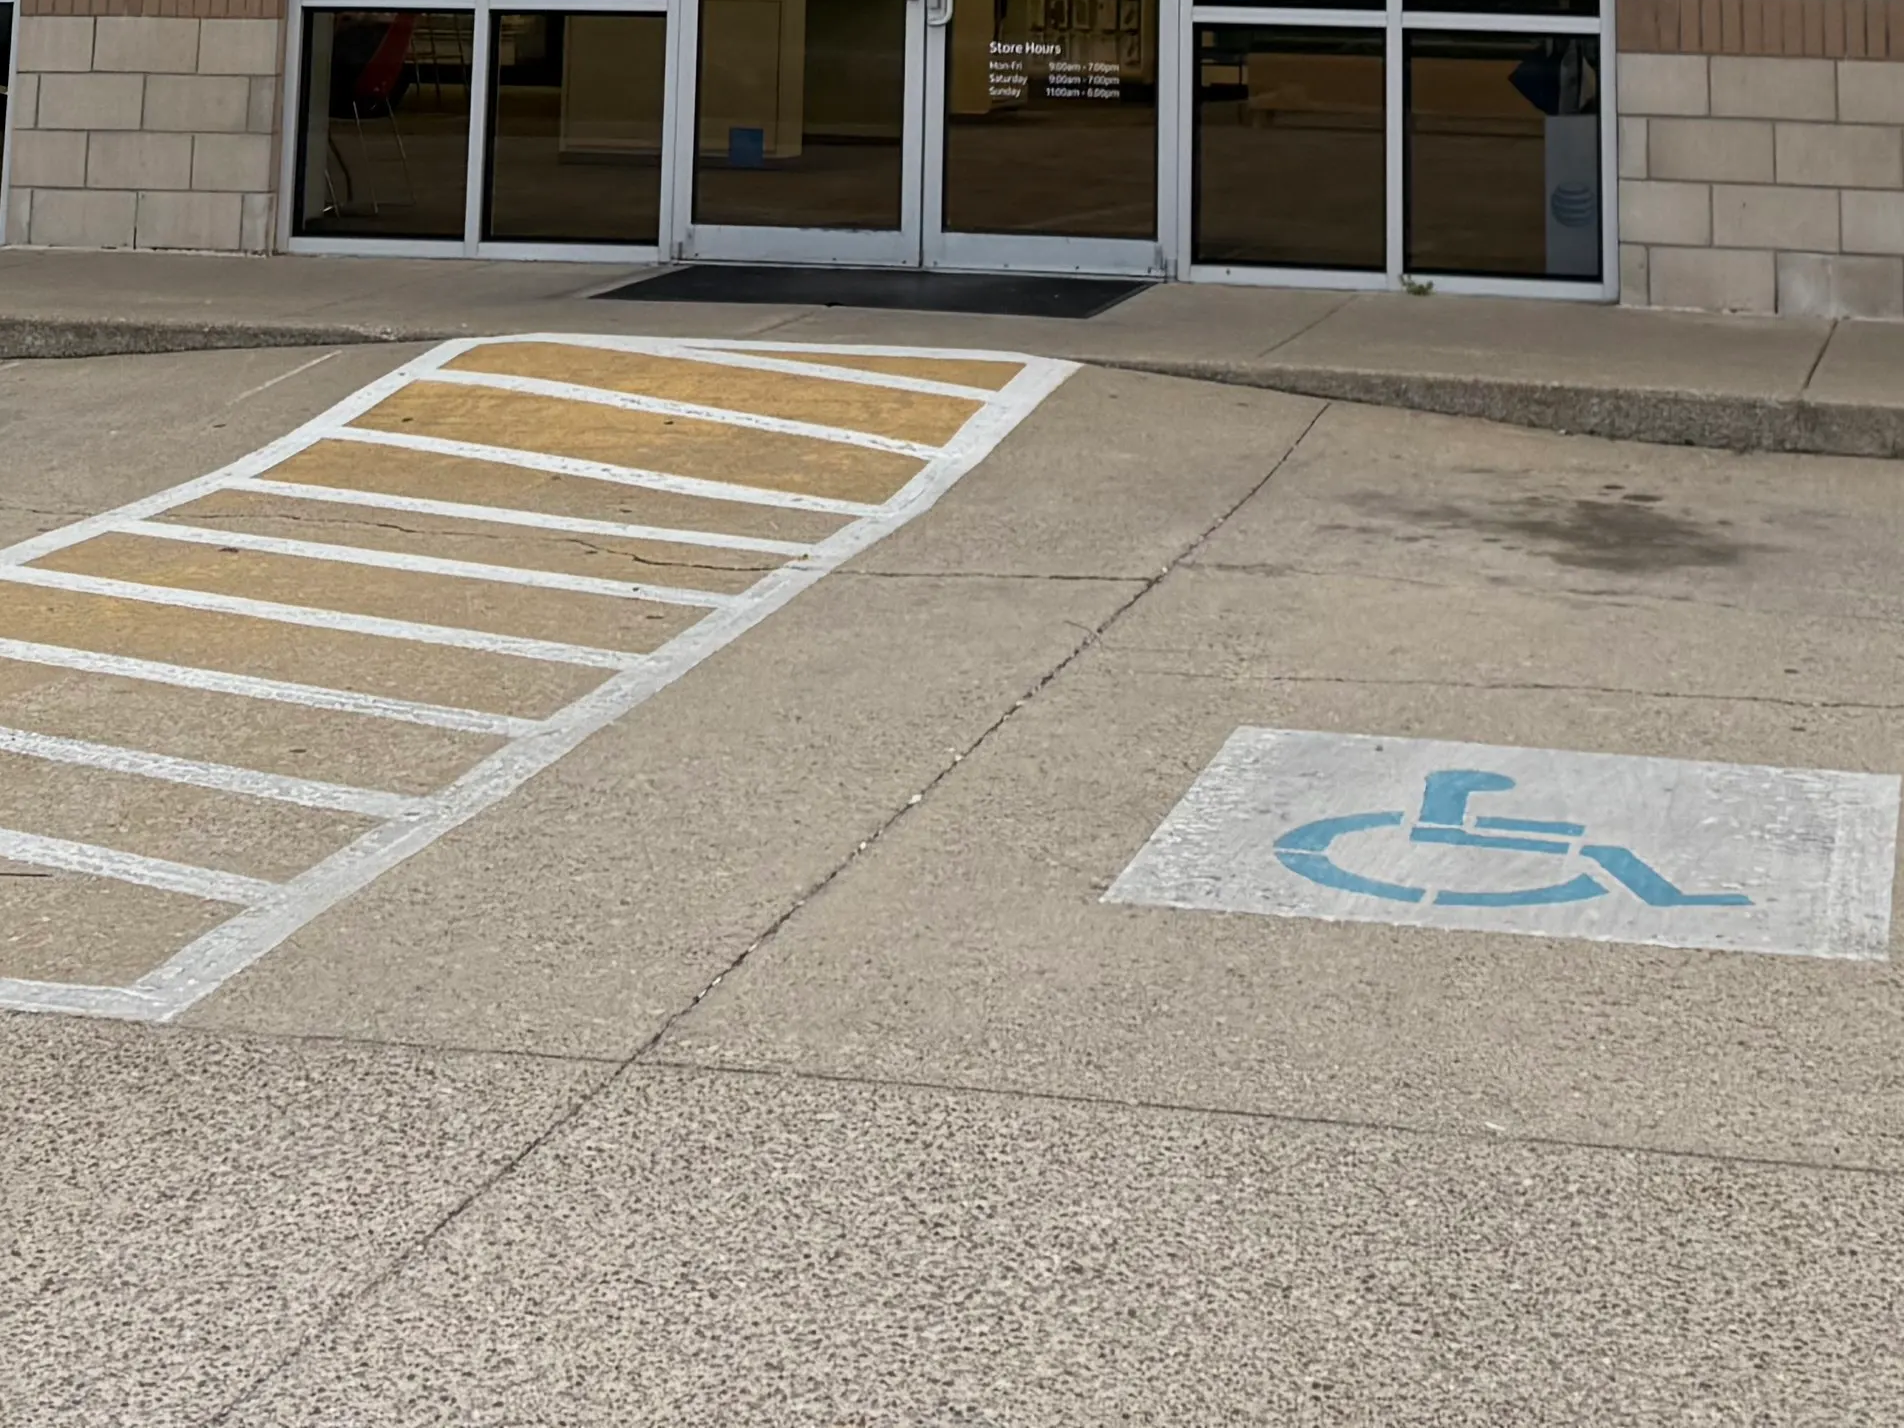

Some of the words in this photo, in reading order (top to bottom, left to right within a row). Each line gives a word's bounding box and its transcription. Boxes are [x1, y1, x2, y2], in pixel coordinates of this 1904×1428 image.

[989, 41, 1023, 54] Store
[1025, 42, 1062, 55] Hours
[989, 74, 1028, 85] Saturday
[989, 86, 1021, 98] Sunday
